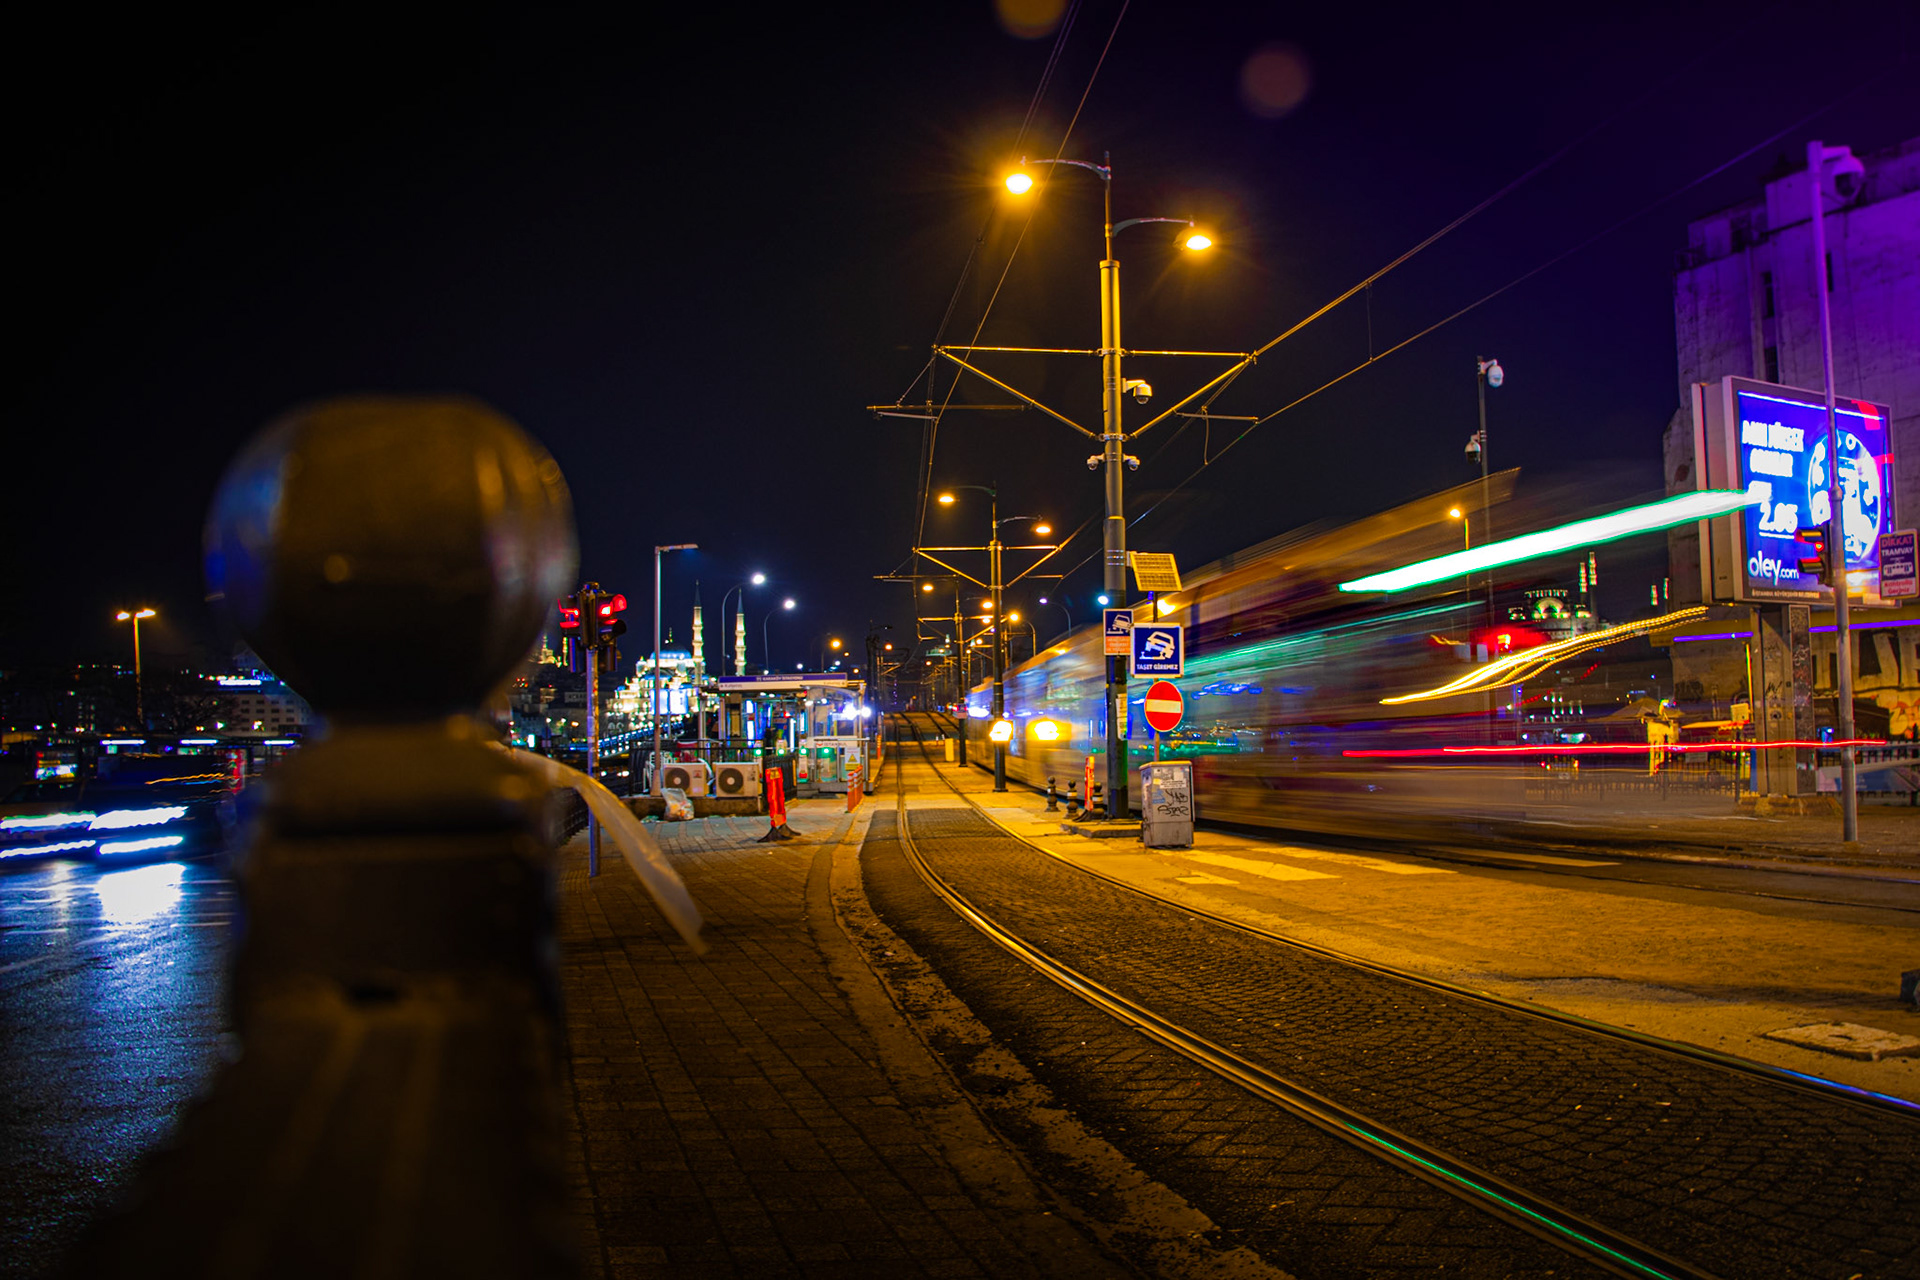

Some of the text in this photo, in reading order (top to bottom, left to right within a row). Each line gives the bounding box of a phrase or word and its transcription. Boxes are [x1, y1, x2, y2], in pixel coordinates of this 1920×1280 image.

[1882, 536, 1913, 548] DİKKAT
[1882, 547, 1913, 556] TRAMVAY
[1749, 550, 1799, 586] oley.com
